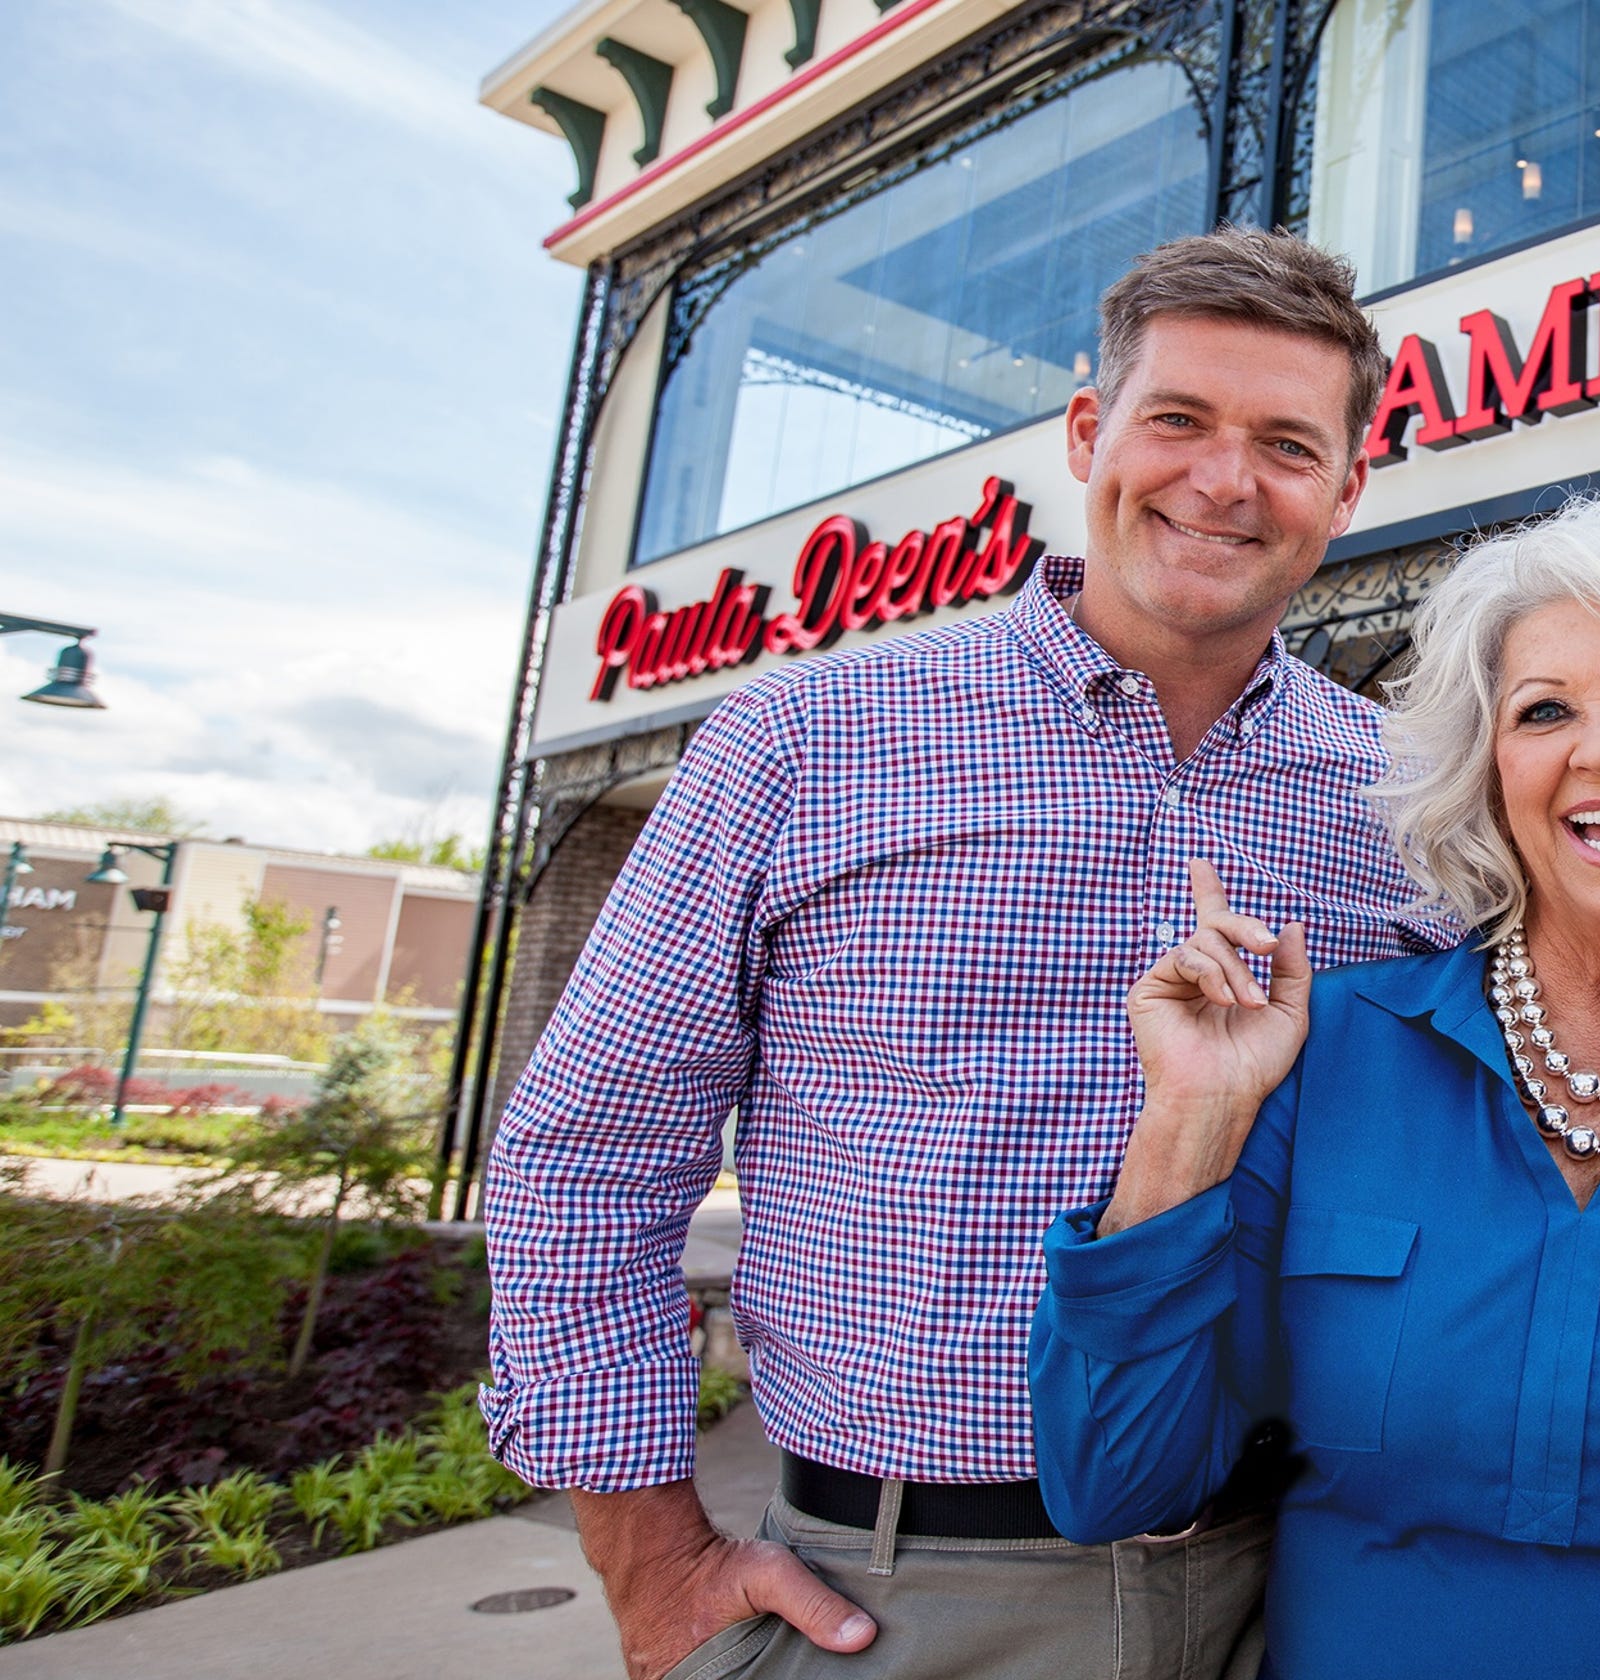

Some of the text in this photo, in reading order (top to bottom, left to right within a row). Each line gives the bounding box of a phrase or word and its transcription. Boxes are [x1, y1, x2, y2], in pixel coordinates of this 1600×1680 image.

[588, 475, 1046, 701] Paula Deen's
[4, 885, 78, 912] HAM
